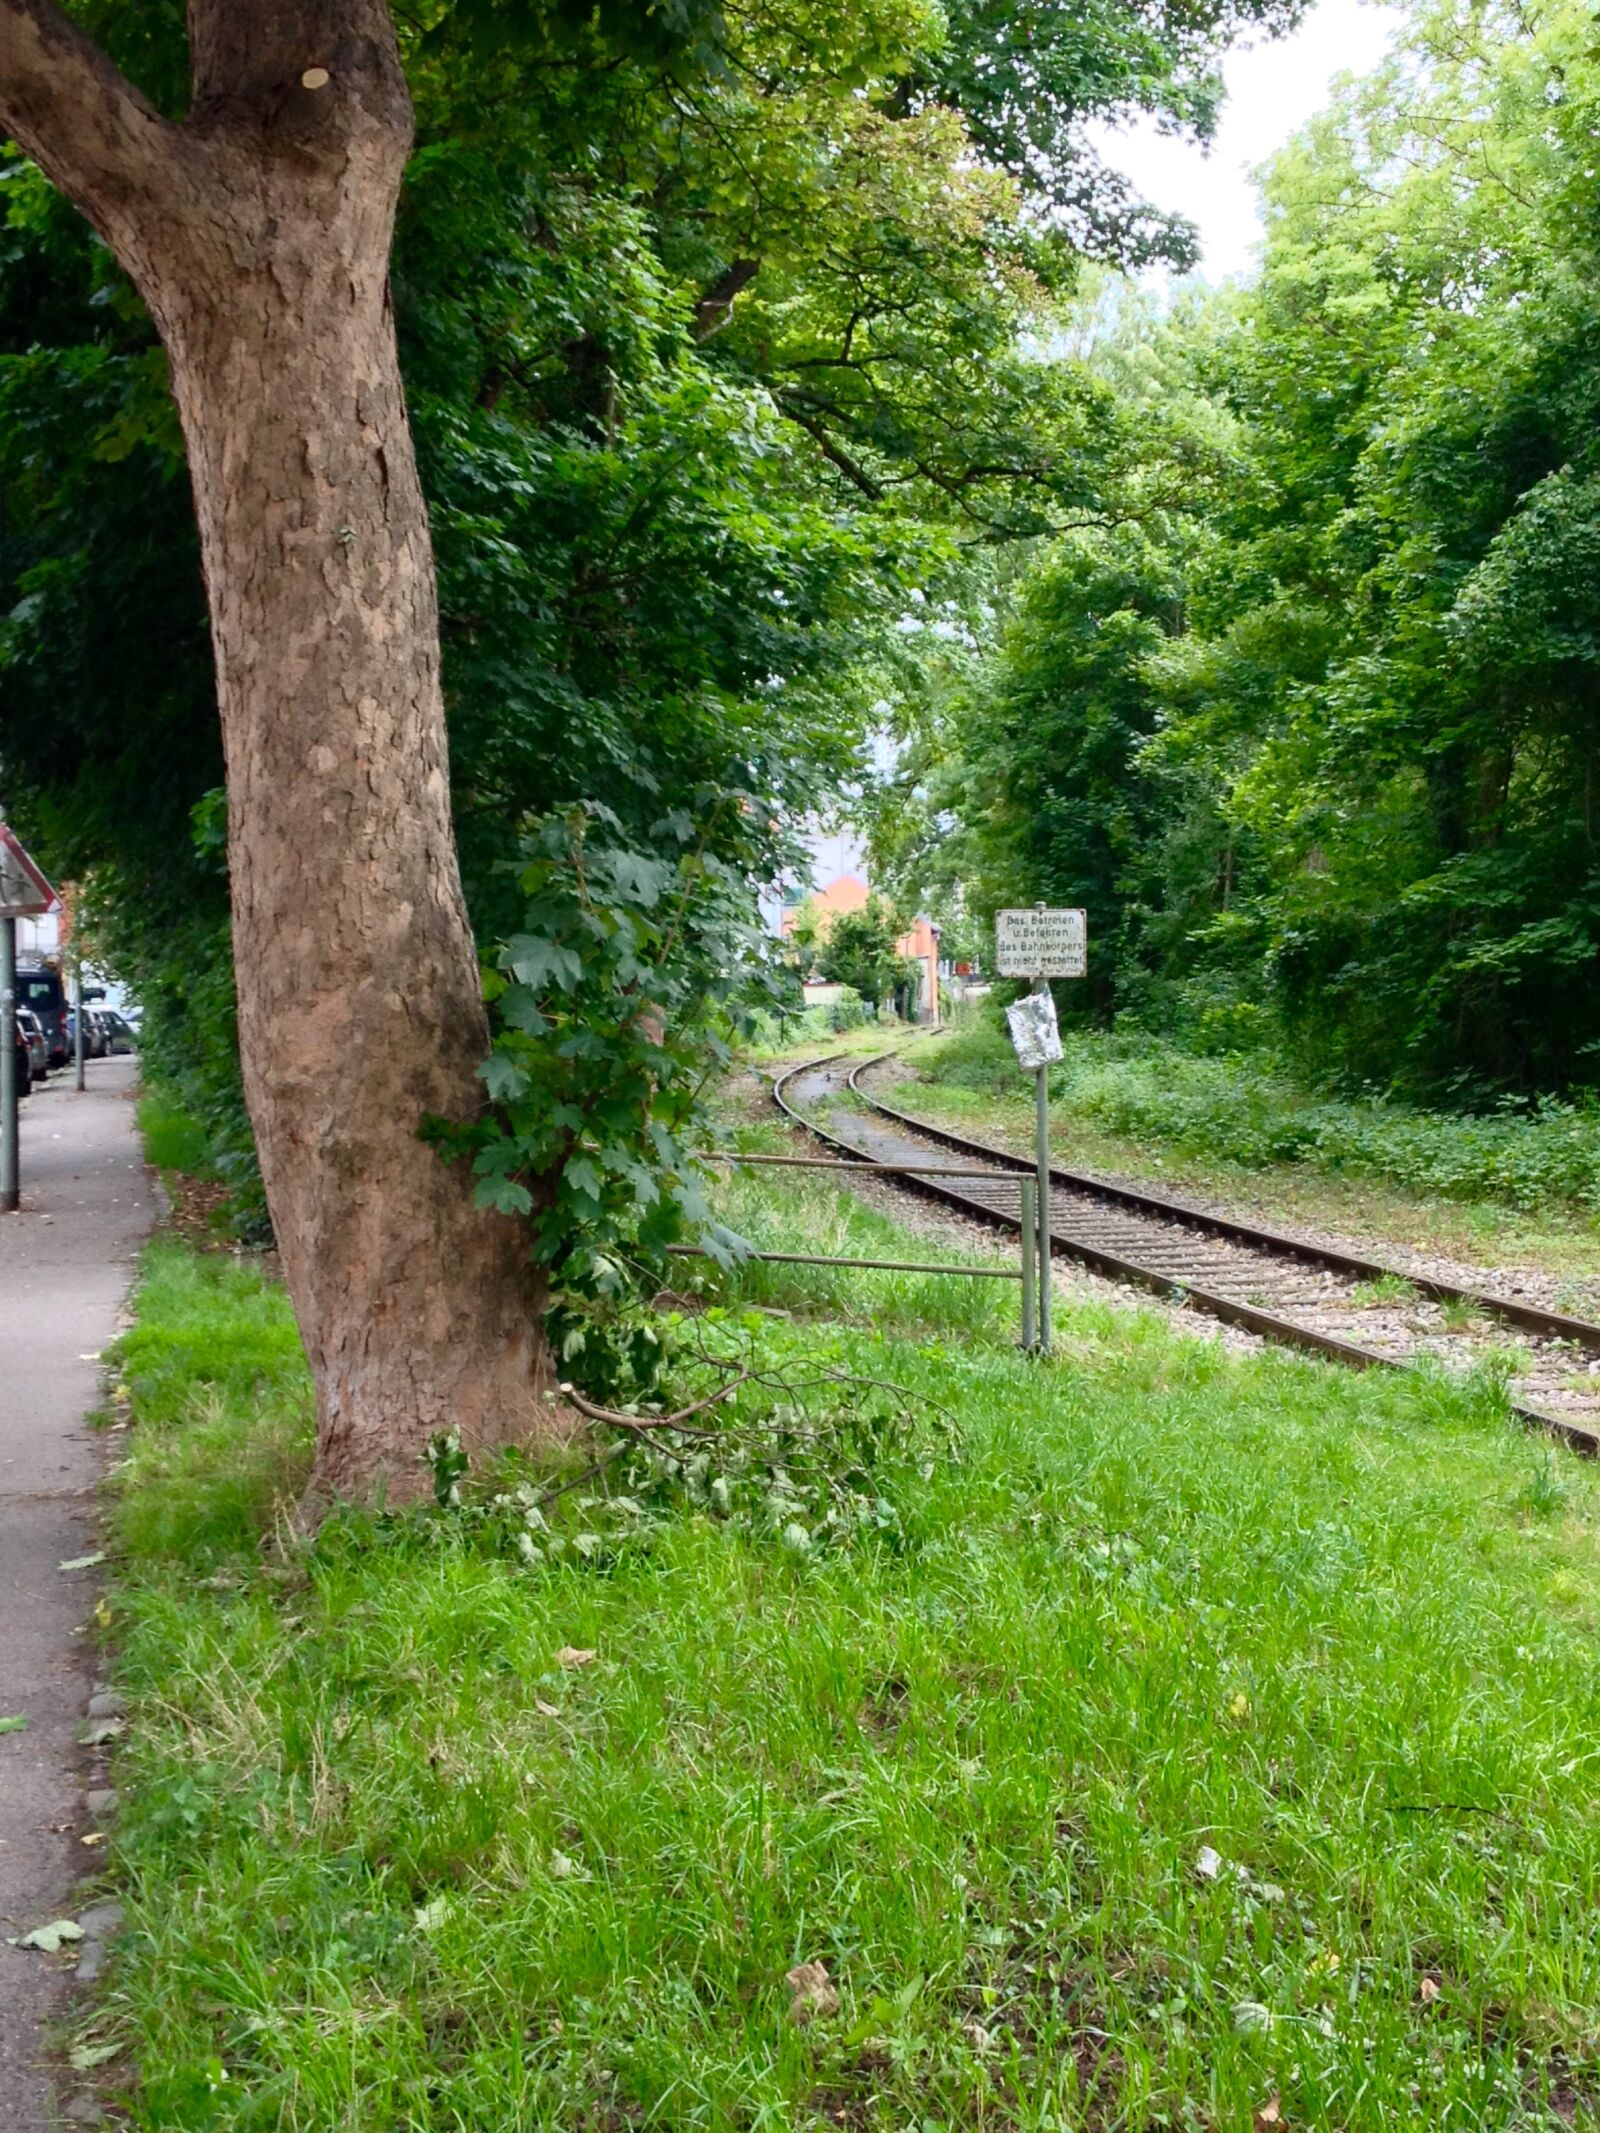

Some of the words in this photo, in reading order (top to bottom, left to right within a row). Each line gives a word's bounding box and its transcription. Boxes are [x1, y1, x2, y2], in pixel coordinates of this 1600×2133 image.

[1007, 915, 1025, 925] Das
[1031, 915, 1074, 925] Betreten
[999, 941, 1017, 951] des
